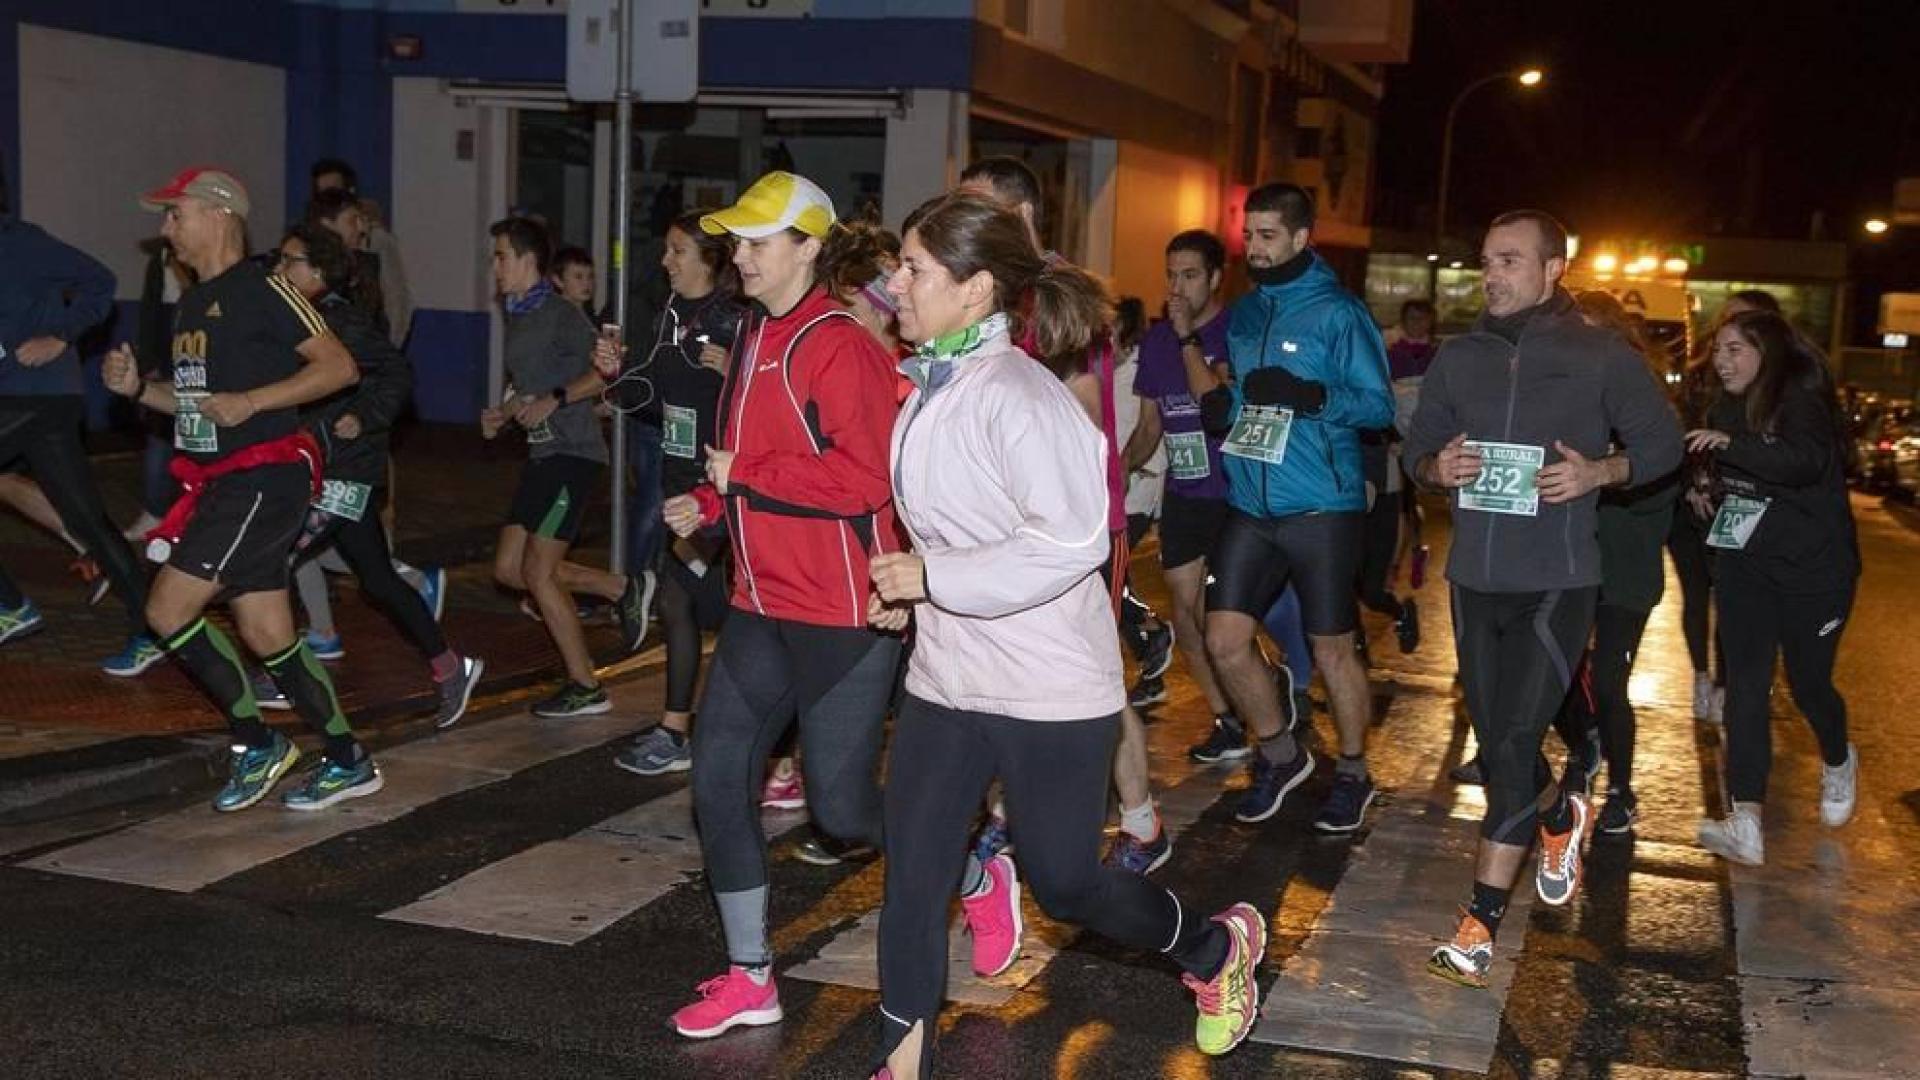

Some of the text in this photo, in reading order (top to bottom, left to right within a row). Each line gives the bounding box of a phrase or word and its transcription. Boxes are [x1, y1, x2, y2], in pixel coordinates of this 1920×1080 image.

[1238, 422, 1273, 446] 251
[1493, 448, 1537, 462] RURAL
[1473, 466, 1521, 494] 252
